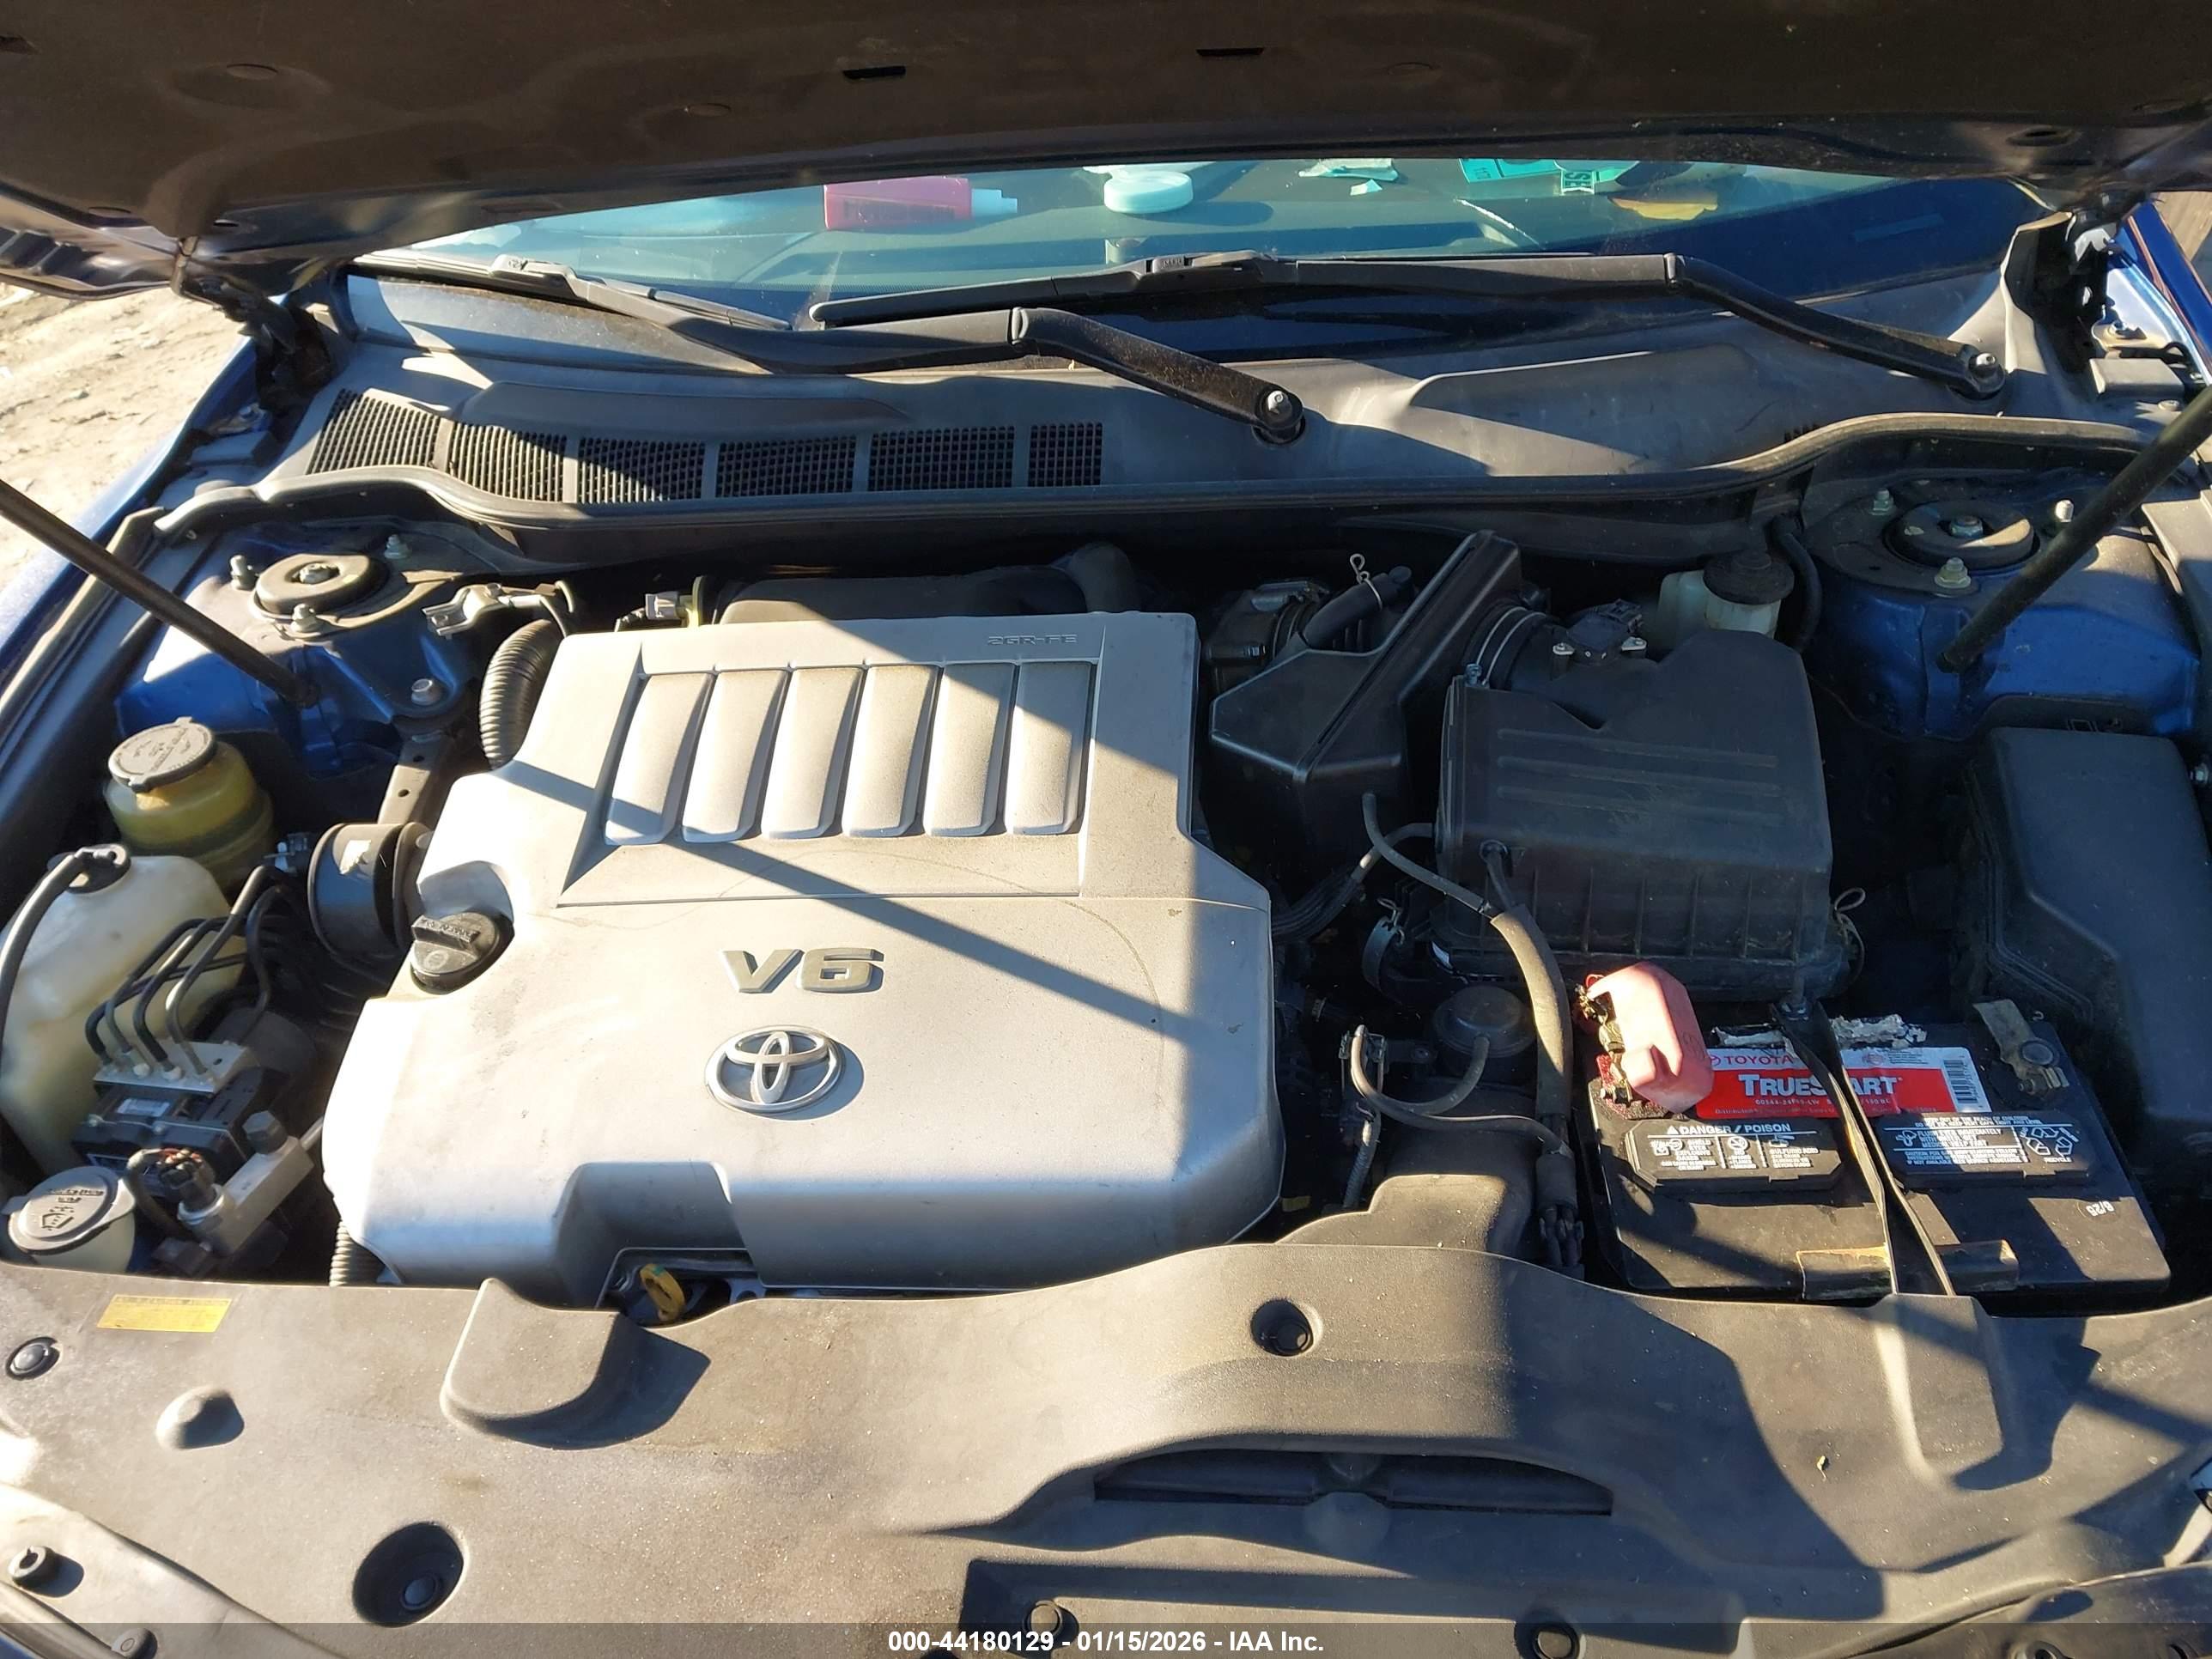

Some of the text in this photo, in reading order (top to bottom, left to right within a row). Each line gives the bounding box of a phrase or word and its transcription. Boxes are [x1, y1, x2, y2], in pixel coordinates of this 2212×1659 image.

[988, 635, 1078, 645] 2GR-FE
[719, 948, 884, 994] V6
[1724, 1055, 1794, 1065] TOYOTA
[1738, 1073, 1897, 1097] TRUESART
[1679, 1123, 1791, 1134] DANGER / POISON
